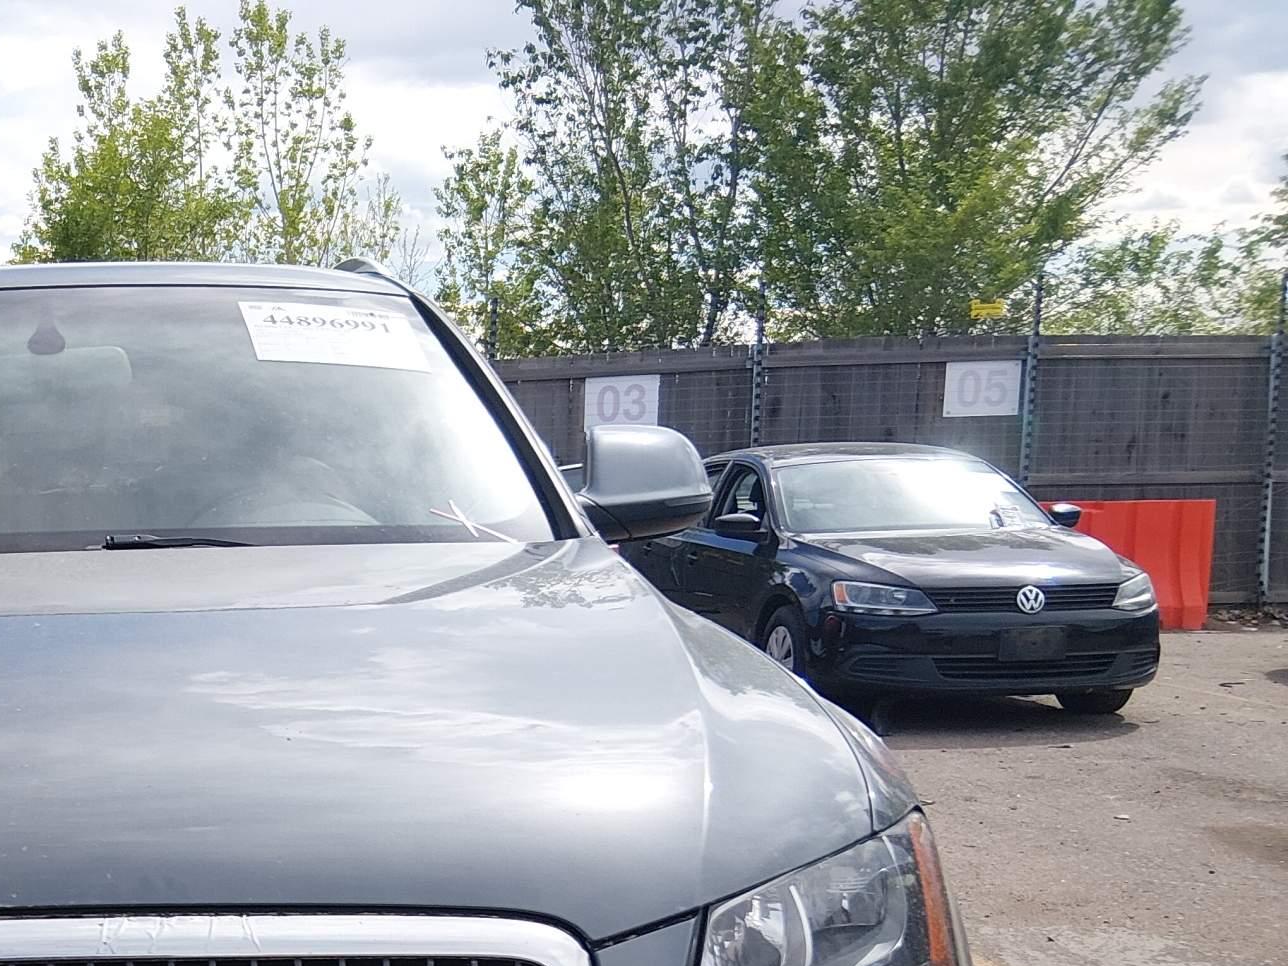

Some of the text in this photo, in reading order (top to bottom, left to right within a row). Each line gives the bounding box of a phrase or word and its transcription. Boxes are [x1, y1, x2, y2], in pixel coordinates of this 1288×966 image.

[263, 313, 390, 334] 44896991
[597, 384, 647, 422] 03
[957, 369, 1009, 408] 05
